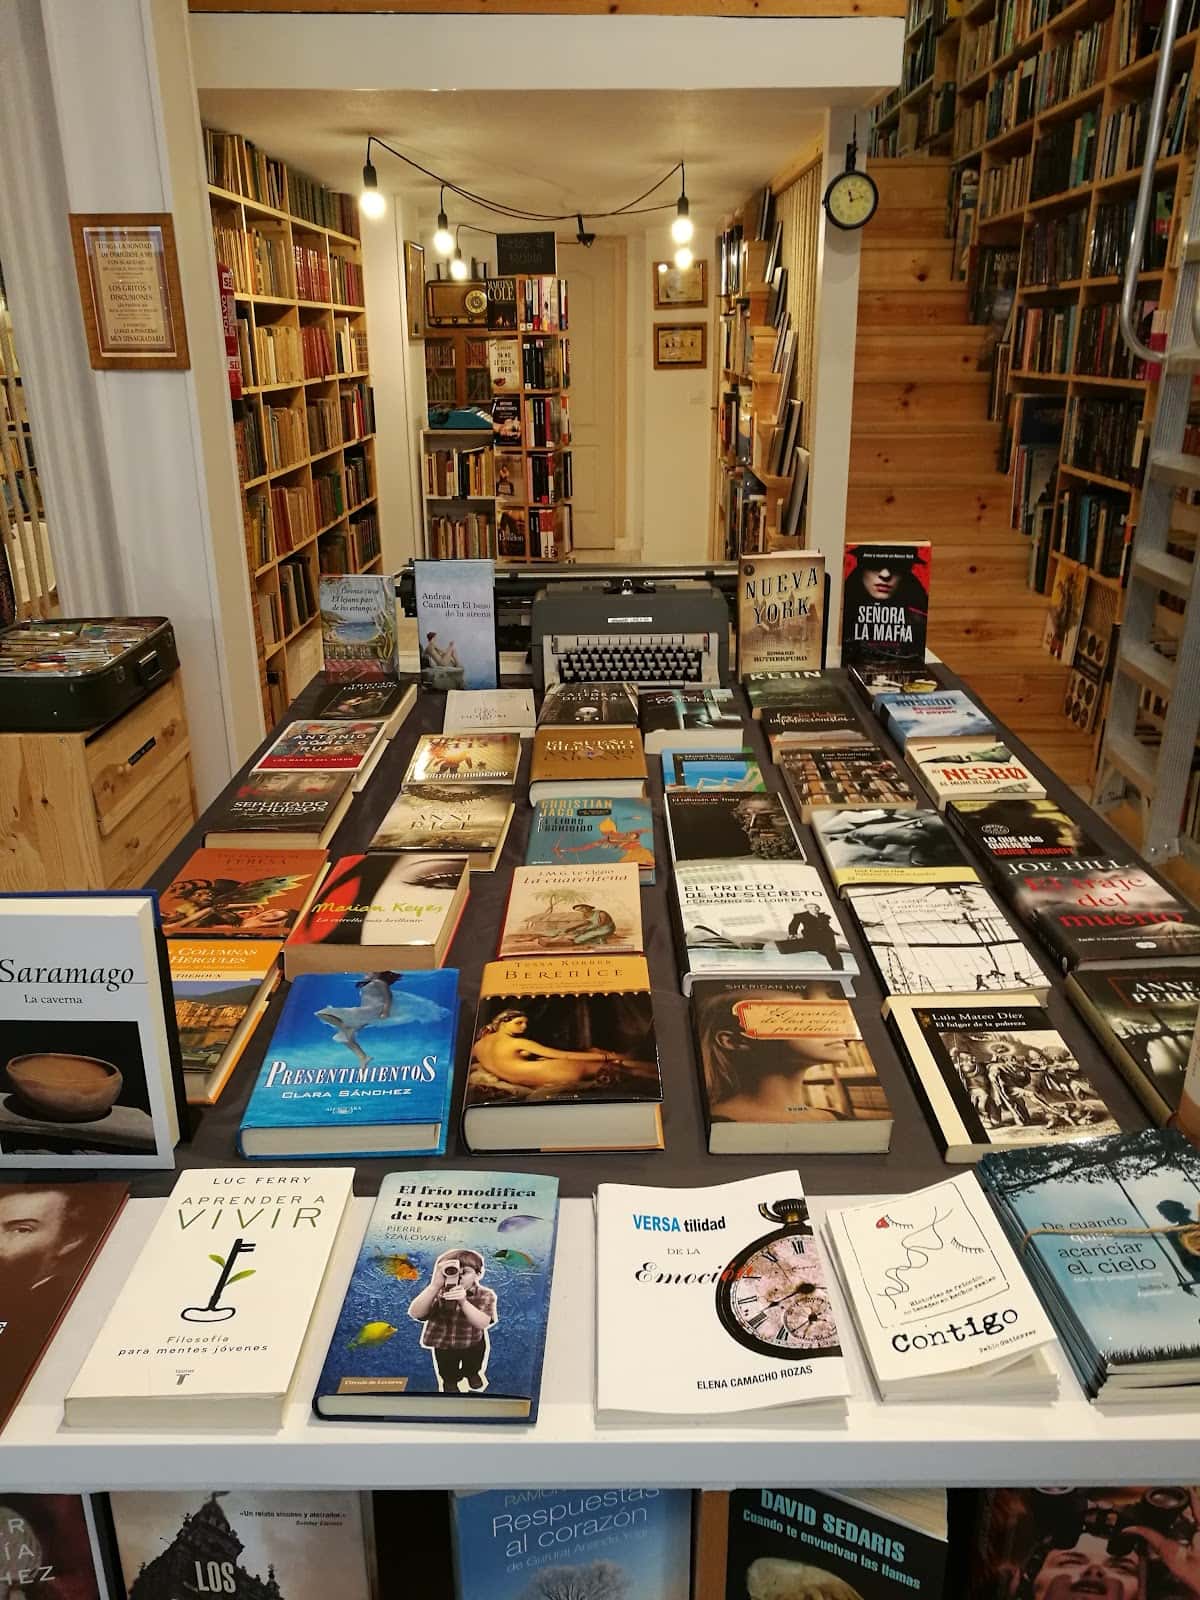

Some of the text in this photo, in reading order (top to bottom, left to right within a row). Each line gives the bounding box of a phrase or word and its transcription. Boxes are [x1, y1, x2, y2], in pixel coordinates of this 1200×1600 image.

[487, 287, 515, 301] COLE
[745, 567, 818, 600] NUEVA
[422, 592, 451, 600] Andrea
[753, 597, 811, 625] YORK
[857, 602, 905, 625] SEÑORA
[854, 623, 913, 643] LA MAFIA
[750, 670, 822, 681] KLEIN
[941, 767, 1028, 781] NESBØ
[1008, 859, 1130, 876] JOE HILL
[1023, 876, 1147, 895] El traje
[743, 890, 823, 898] SECRETO
[1078, 892, 1128, 907] del
[311, 902, 443, 917] Marian Keyes
[1058, 911, 1185, 928] muerto
[0, 958, 135, 992] Saramago
[1135, 981, 1193, 993] ANNE
[24, 993, 84, 1005] La caverna
[1132, 991, 1200, 1003] PERR
[932, 1013, 956, 1021] Luis
[959, 1012, 995, 1021] Mateo
[946, 1021, 971, 1029] fulgor
[264, 1055, 438, 1088] PRESENTIMIENTOS
[281, 1087, 413, 1100] CLARA SÁNCHEZ
[212, 1175, 312, 1186] LUC FERRY
[399, 1184, 537, 1198] El frío modifica
[181, 1194, 326, 1206] APRENDER A
[394, 1197, 520, 1213] la trayectoria
[177, 1206, 323, 1231] VIVIR
[390, 1211, 499, 1225] de los peces
[632, 1214, 727, 1233] VERSA tilidad
[1041, 1215, 1128, 1231] De cuando
[386, 1225, 423, 1234] PIERRE
[383, 1232, 449, 1243] SZALOWSKI
[667, 1247, 701, 1256] DE LA
[1057, 1241, 1144, 1259] acariciar
[1067, 1256, 1157, 1276] el cielo
[892, 1308, 1019, 1353] Contigo
[166, 1334, 230, 1345] Filosofía
[117, 1343, 269, 1357] para mentes jóvenes
[696, 1365, 813, 1390] ELENA CAMACHO ROZAS
[492, 1488, 660, 1538] Respuestas
[506, 1533, 527, 1558] al
[538, 1506, 648, 1548] corazón
[760, 1488, 905, 1563] DAVID SEDARIS
[743, 1508, 922, 1590] Cuando te envuelvan las llamas
[194, 1560, 237, 1593] LOS
